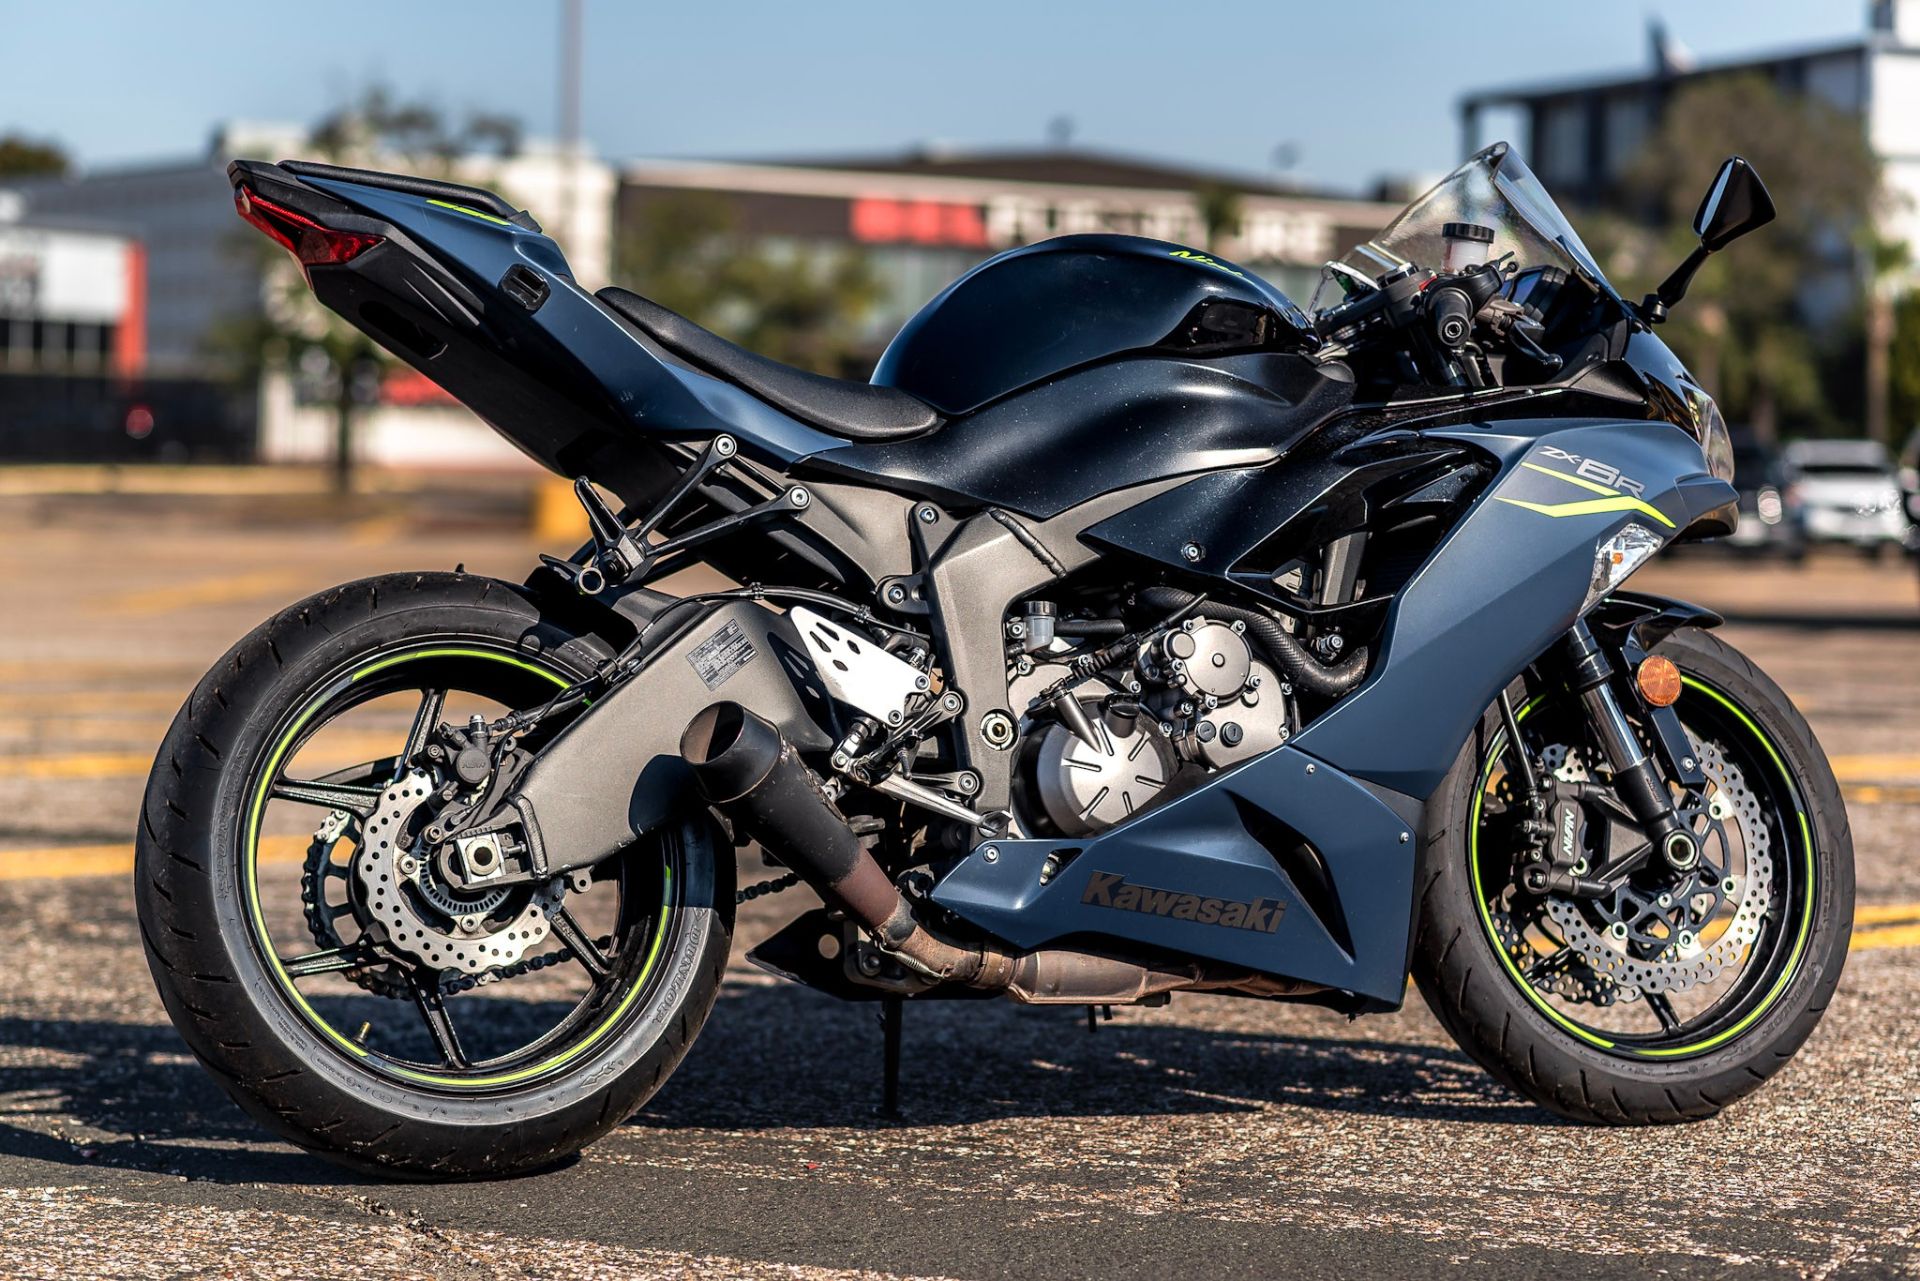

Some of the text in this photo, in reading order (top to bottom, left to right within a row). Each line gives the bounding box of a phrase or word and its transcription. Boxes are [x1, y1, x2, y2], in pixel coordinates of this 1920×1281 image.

[1540, 445, 1646, 499] ZX-6R
[1082, 871, 1288, 933] Kawasaki
[652, 925, 703, 1025] DUNLOP
